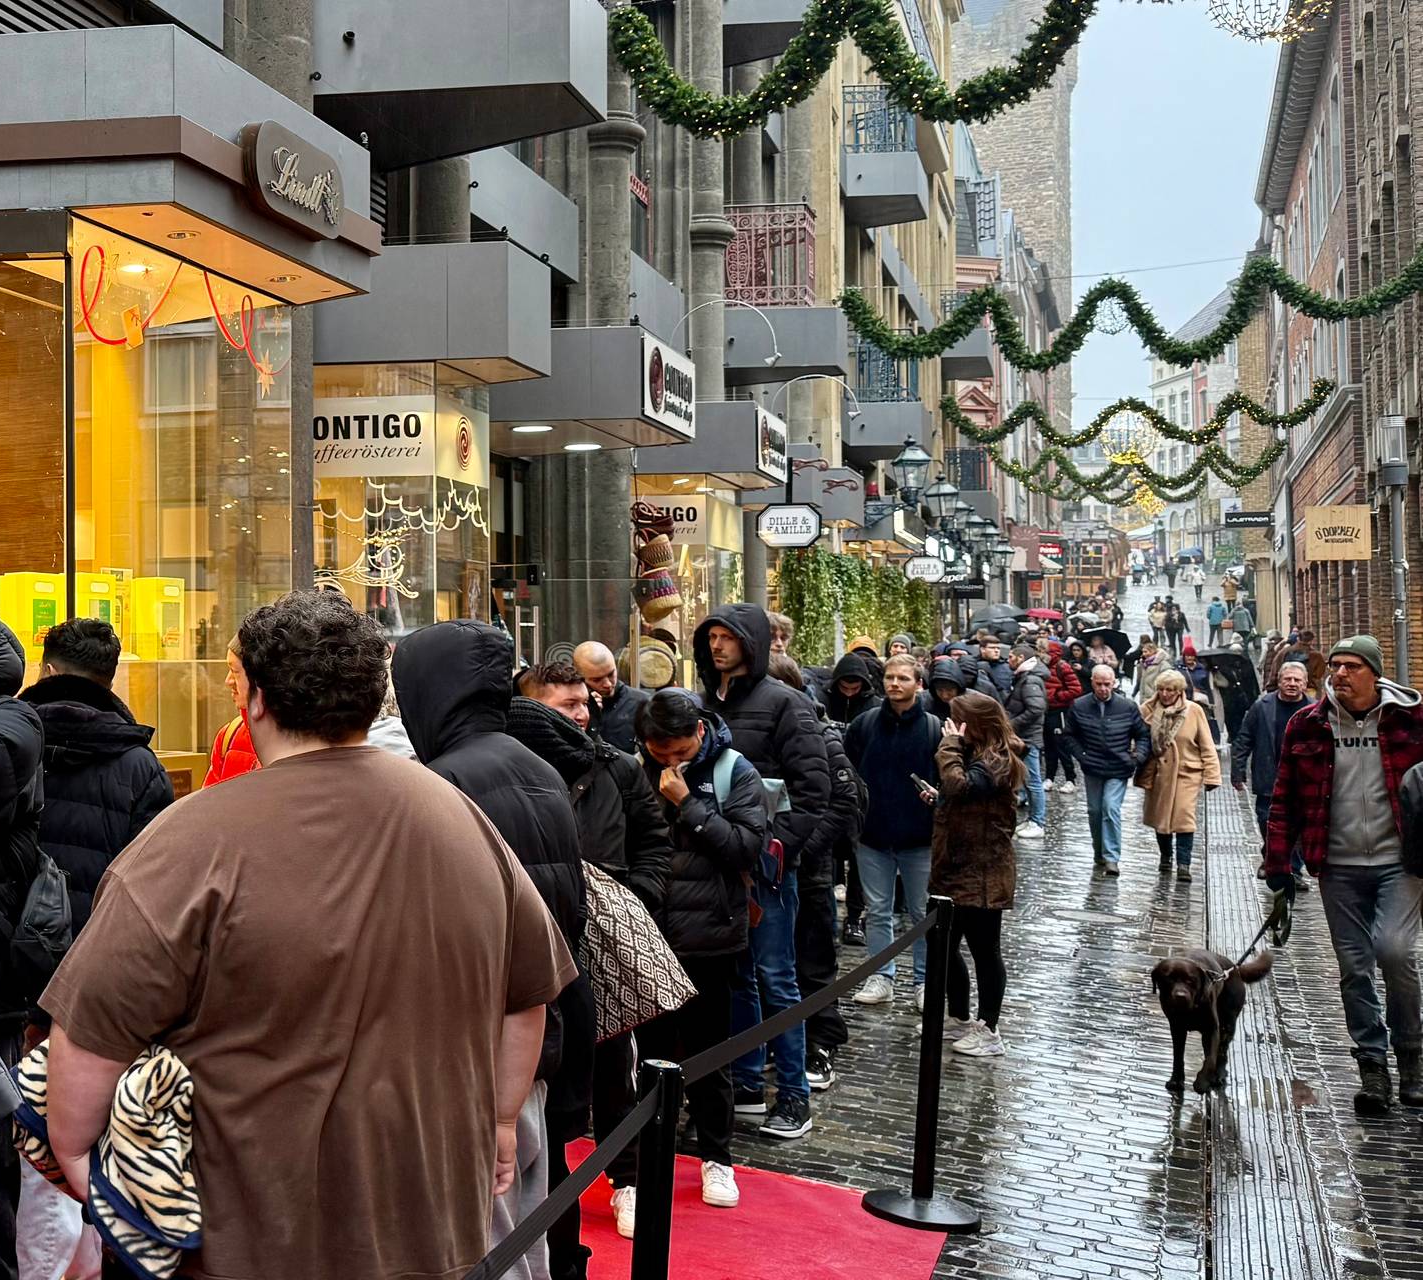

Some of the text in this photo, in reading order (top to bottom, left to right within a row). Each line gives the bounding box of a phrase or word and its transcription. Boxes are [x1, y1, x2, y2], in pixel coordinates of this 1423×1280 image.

[267, 146, 324, 214] Lindt
[664, 362, 693, 405] CONTIGO
[313, 413, 423, 441] ONTIGO
[768, 516, 809, 526] DILLE &
